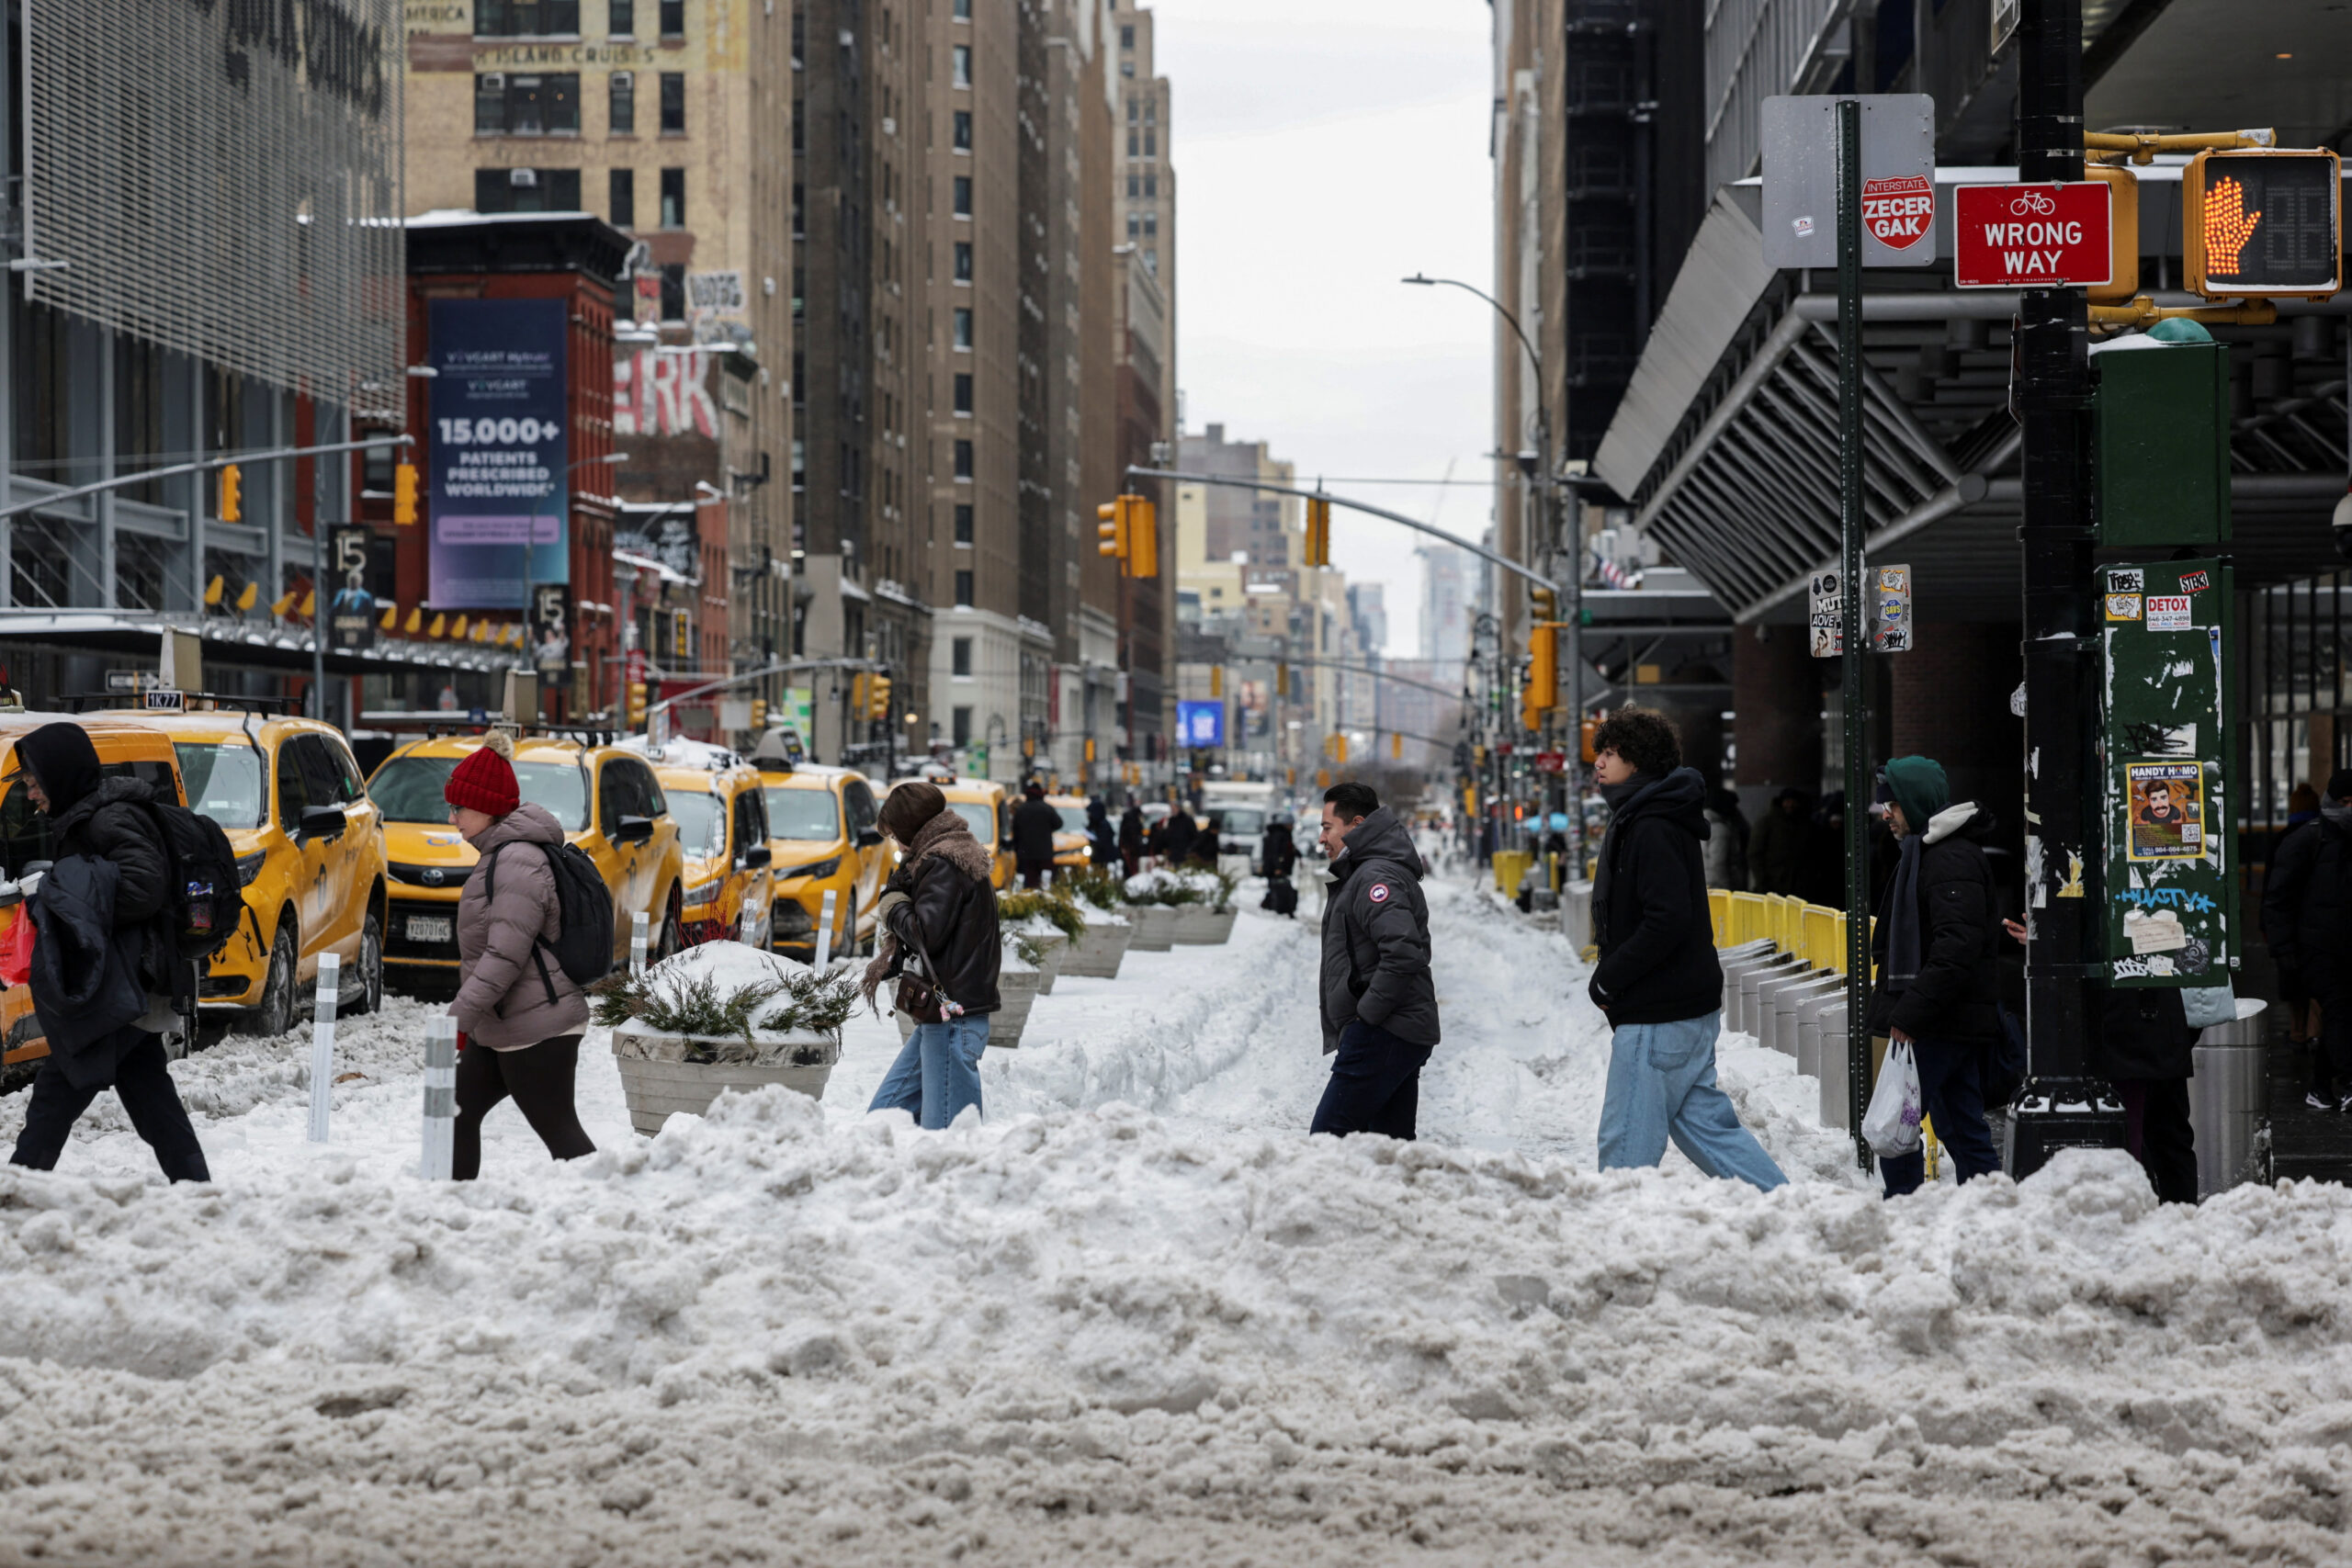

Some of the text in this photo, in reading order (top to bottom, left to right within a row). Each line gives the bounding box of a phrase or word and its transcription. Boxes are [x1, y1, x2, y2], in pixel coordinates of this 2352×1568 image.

[1867, 179, 1925, 193] INTERSTATE
[1863, 196, 1932, 219] ZECER
[1874, 217, 1922, 239] GAK
[1984, 221, 2083, 247] WRONG
[2004, 250, 2064, 275] WAY
[437, 416, 560, 446] 15,000+
[459, 451, 538, 466] PATIENTS
[447, 466, 550, 481] PRESCRIBED
[334, 536, 367, 572] 15
[538, 592, 565, 625] 15
[2148, 598, 2188, 612] DETOX
[150, 694, 177, 707] 1K77
[2131, 765, 2198, 777] HANDY HOMO
